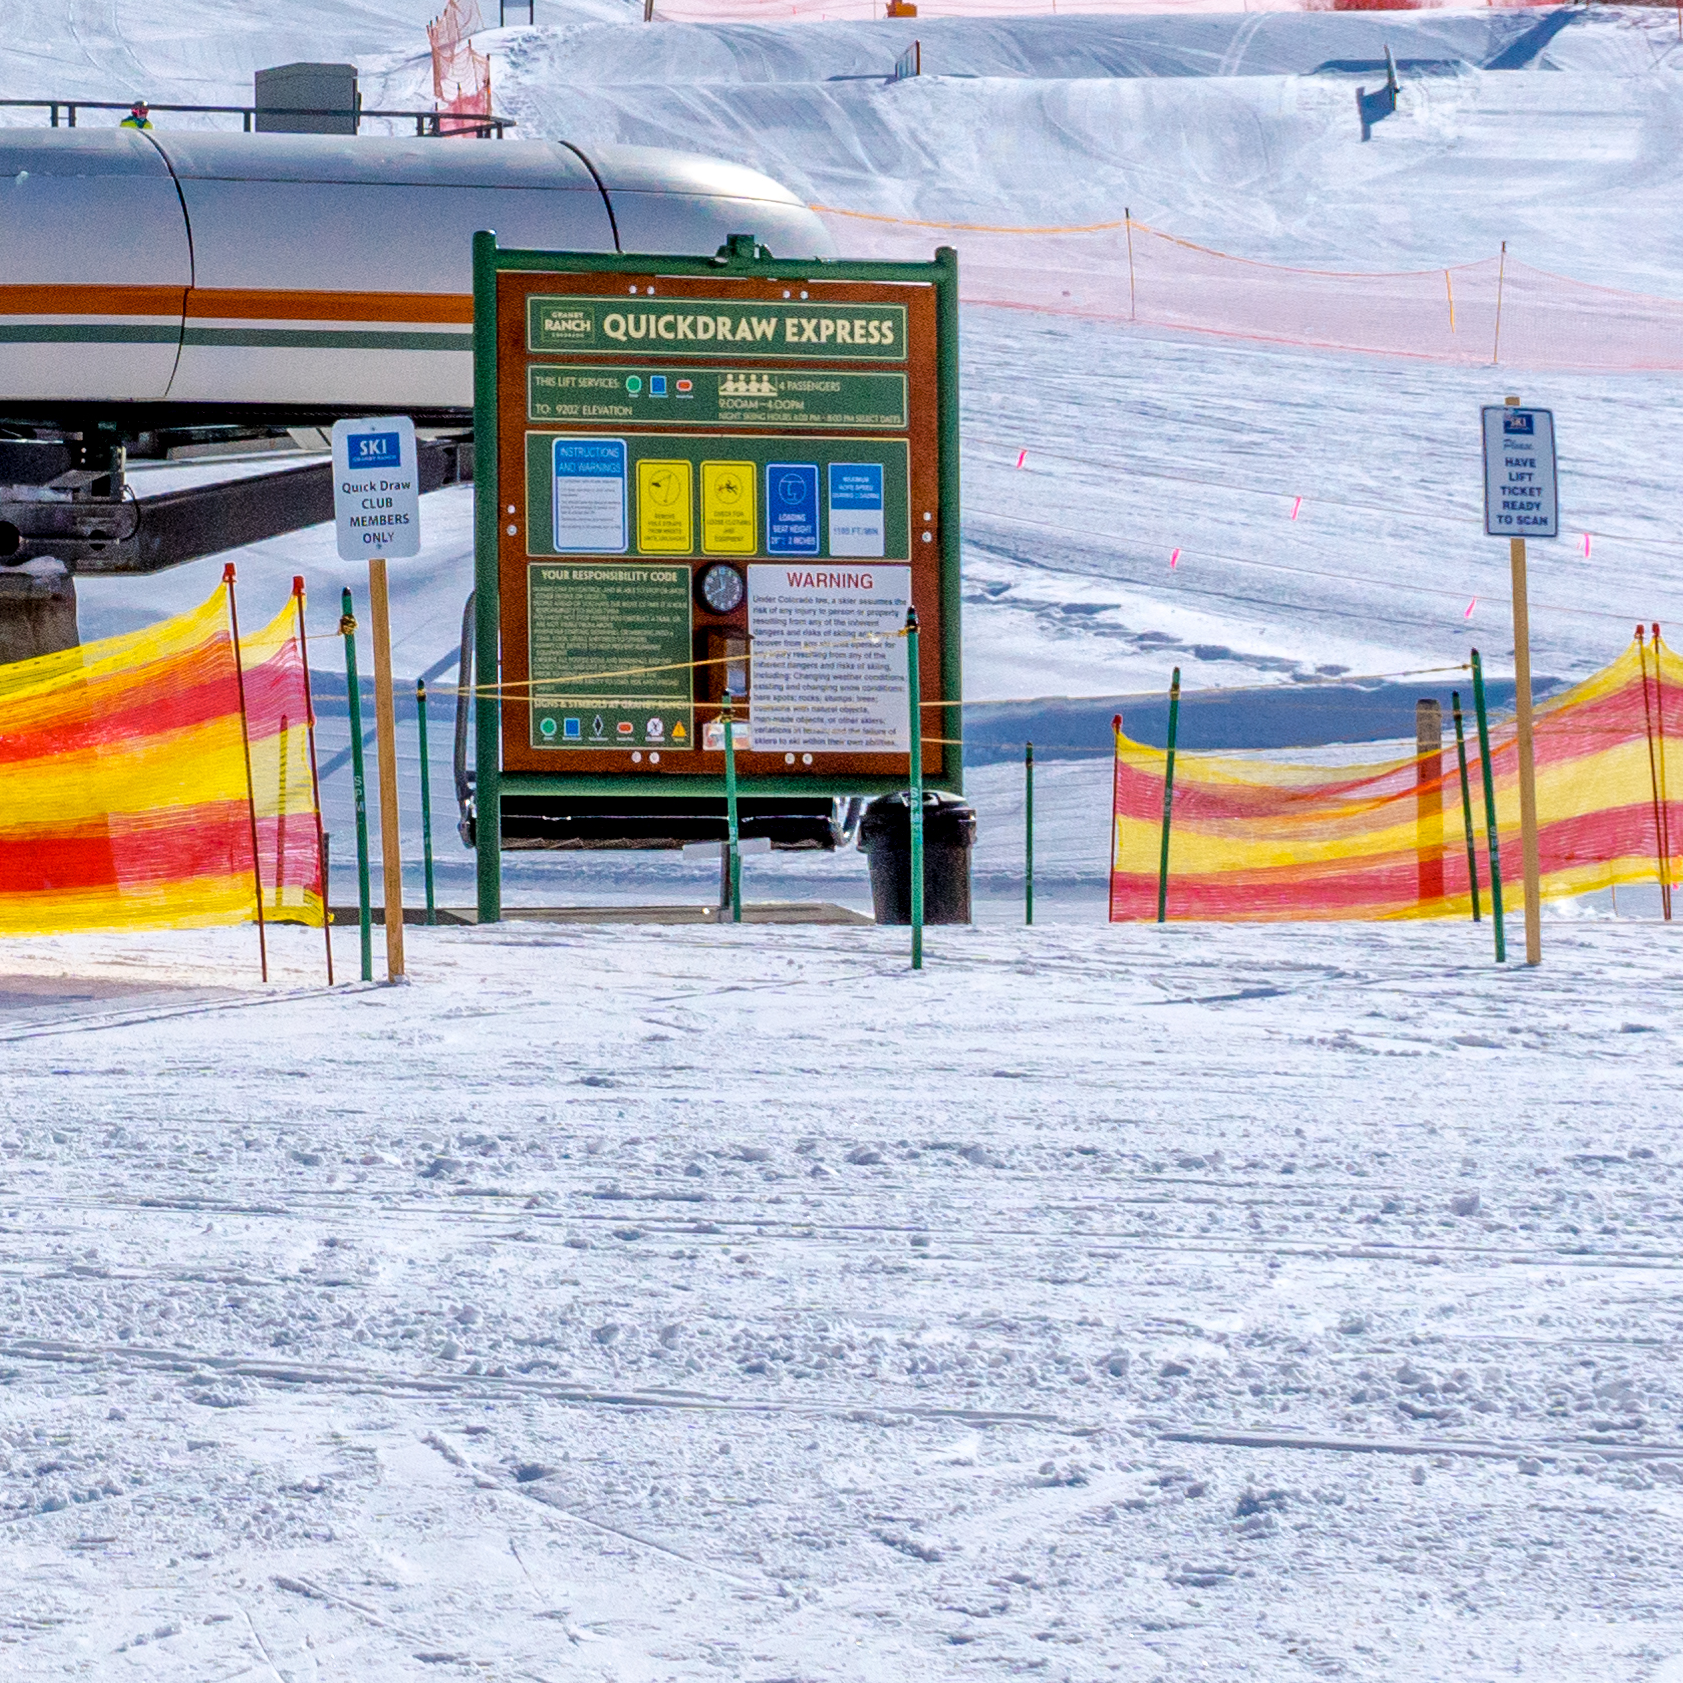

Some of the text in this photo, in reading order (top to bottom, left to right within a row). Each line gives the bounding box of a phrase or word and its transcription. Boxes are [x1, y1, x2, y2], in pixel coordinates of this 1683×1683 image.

[545, 319, 591, 331] RANCH
[603, 313, 894, 345] QUICKDRAW EXPRESS
[536, 377, 556, 387] THIS
[558, 377, 575, 387] LIFT
[787, 381, 840, 392] PASSENGERS
[583, 405, 633, 415] ELEVATION
[1510, 417, 1526, 426] SKI
[360, 439, 387, 456] SKI
[560, 447, 620, 458] INSTRUCTIONS
[1505, 457, 1536, 468] HAVE
[558, 463, 621, 473] AND WARNINGS
[1508, 473, 1534, 482] LIFT
[342, 480, 411, 494] Quick Draw
[1500, 486, 1542, 496] TICKET
[362, 498, 393, 509] CLUB
[1502, 501, 1542, 511] READY
[350, 514, 409, 527] MEMBERS
[1496, 515, 1548, 525] TO SCAN
[363, 532, 394, 543] ONLY
[542, 570, 677, 581] YOUR RESPONSIBILITY CODE
[787, 572, 873, 589] WARNING
[753, 595, 776, 603] Under
[753, 629, 785, 637] dangers
[833, 630, 856, 638] skiing
[793, 673, 830, 681] Changing
[802, 683, 838, 692] changing
[754, 737, 777, 745] skiers
[779, 737, 786, 745] to
[789, 737, 801, 745] ski
